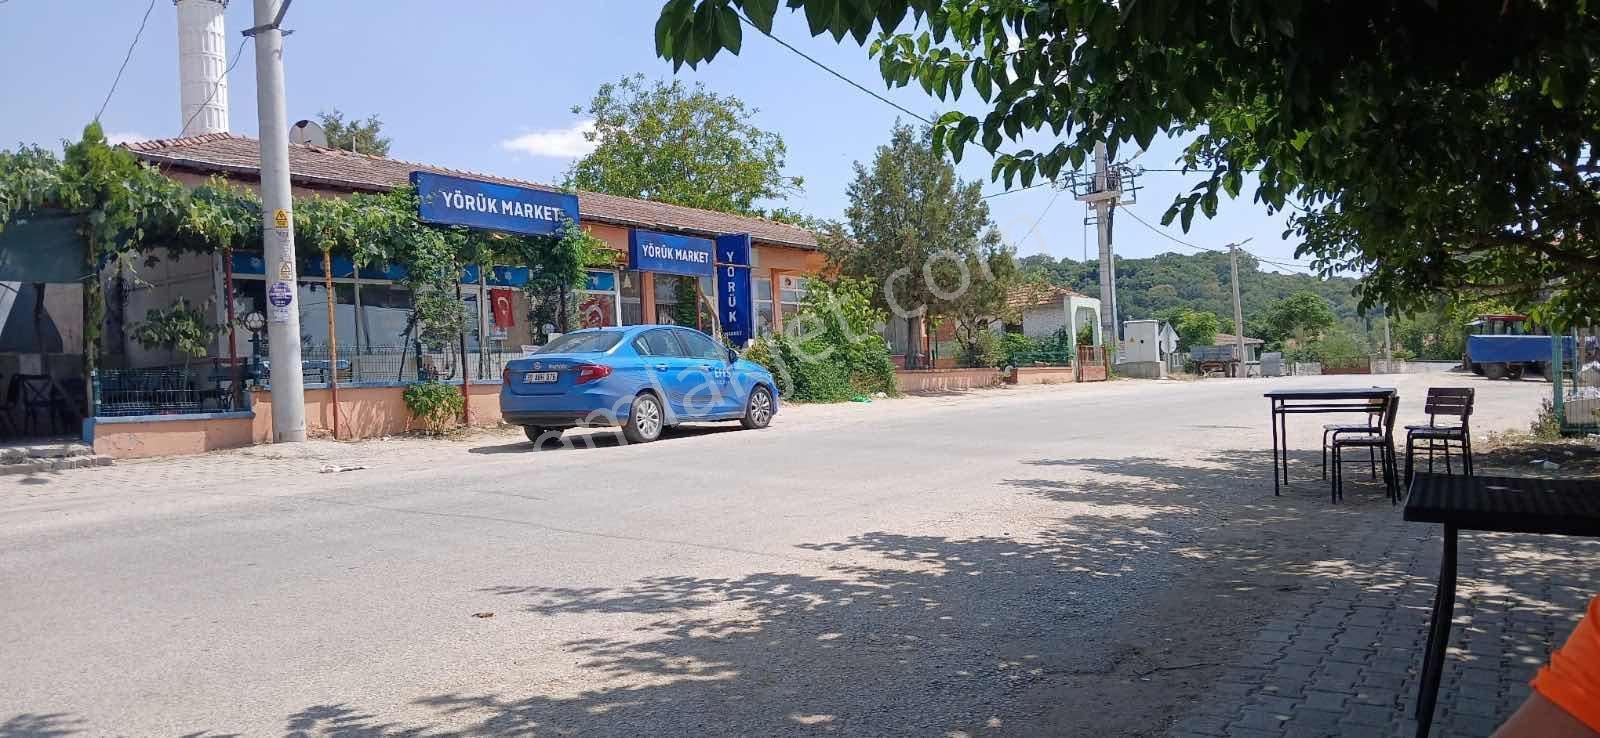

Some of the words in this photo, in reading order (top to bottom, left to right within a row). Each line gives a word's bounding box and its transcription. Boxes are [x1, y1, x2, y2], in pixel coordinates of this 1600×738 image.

[441, 190, 498, 214] YÖRÜK
[501, 199, 561, 222] MARKET
[642, 242, 674, 260] YÖRÜK
[675, 248, 709, 264] MARKET
